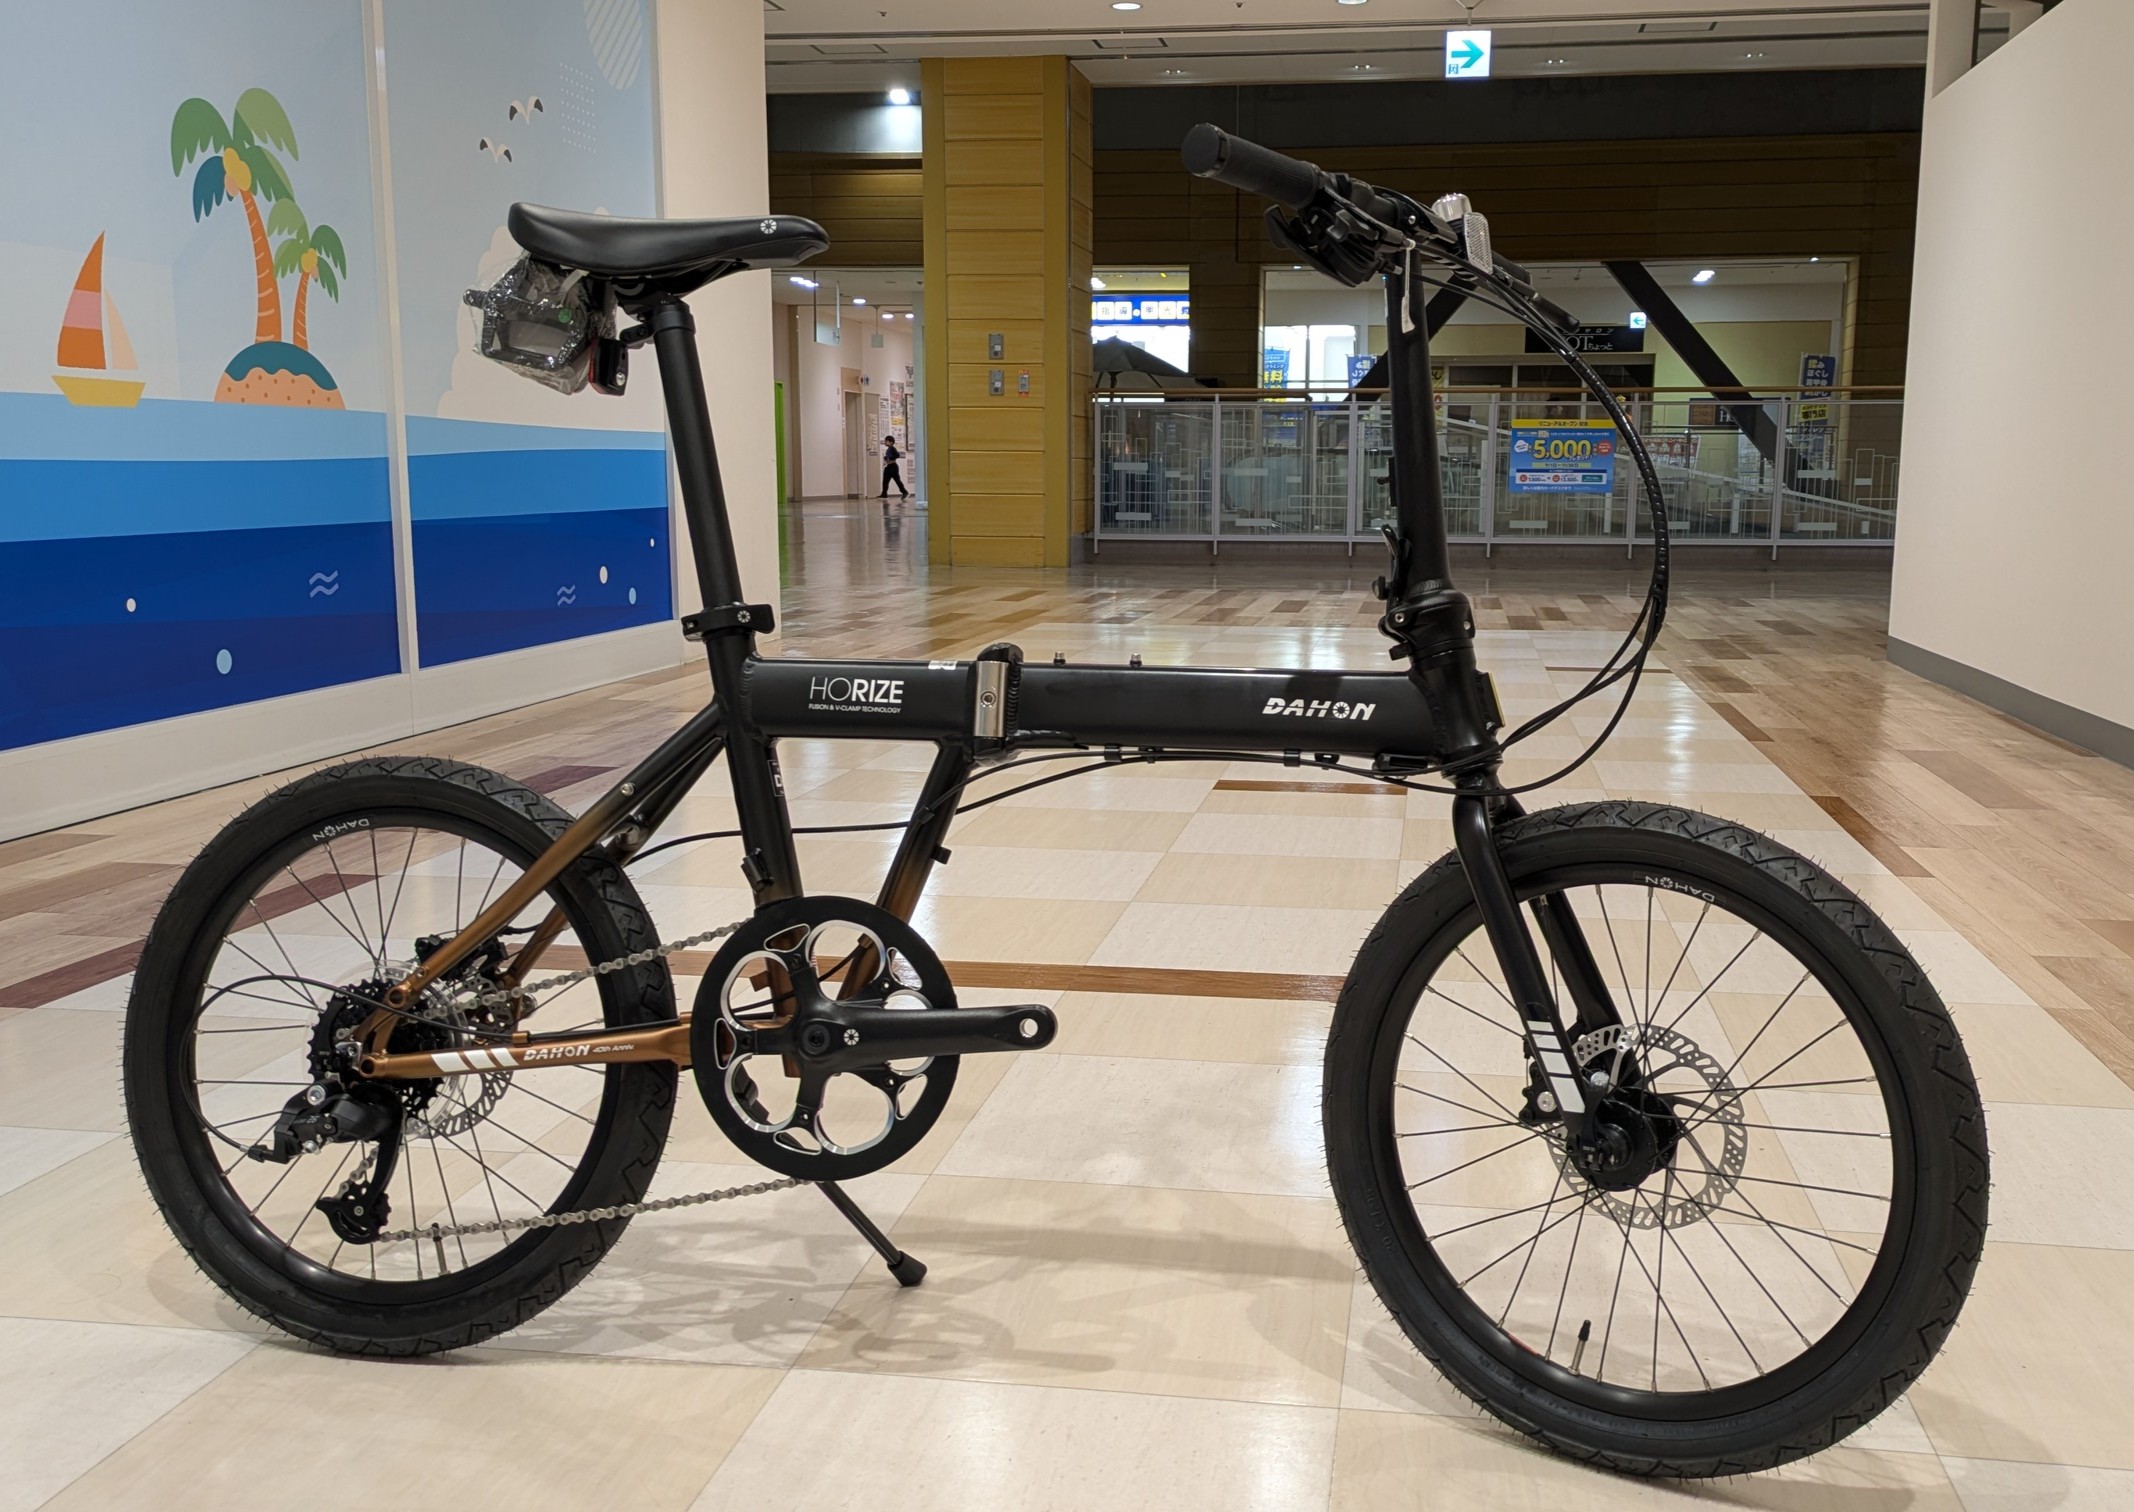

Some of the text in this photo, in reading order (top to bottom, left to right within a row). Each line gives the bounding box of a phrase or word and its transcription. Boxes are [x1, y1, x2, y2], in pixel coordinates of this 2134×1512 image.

[1533, 439, 1592, 459] 5,000
[810, 676, 905, 703] HORIZE
[808, 703, 829, 711] FUSION
[835, 704, 861, 712] V-CLAMP
[862, 705, 902, 714] TECHNOLOGY
[1262, 697, 1376, 721] DAHON
[312, 818, 370, 842] DAHON
[1645, 875, 1715, 902] DAHON
[523, 1044, 591, 1061] DAHON
